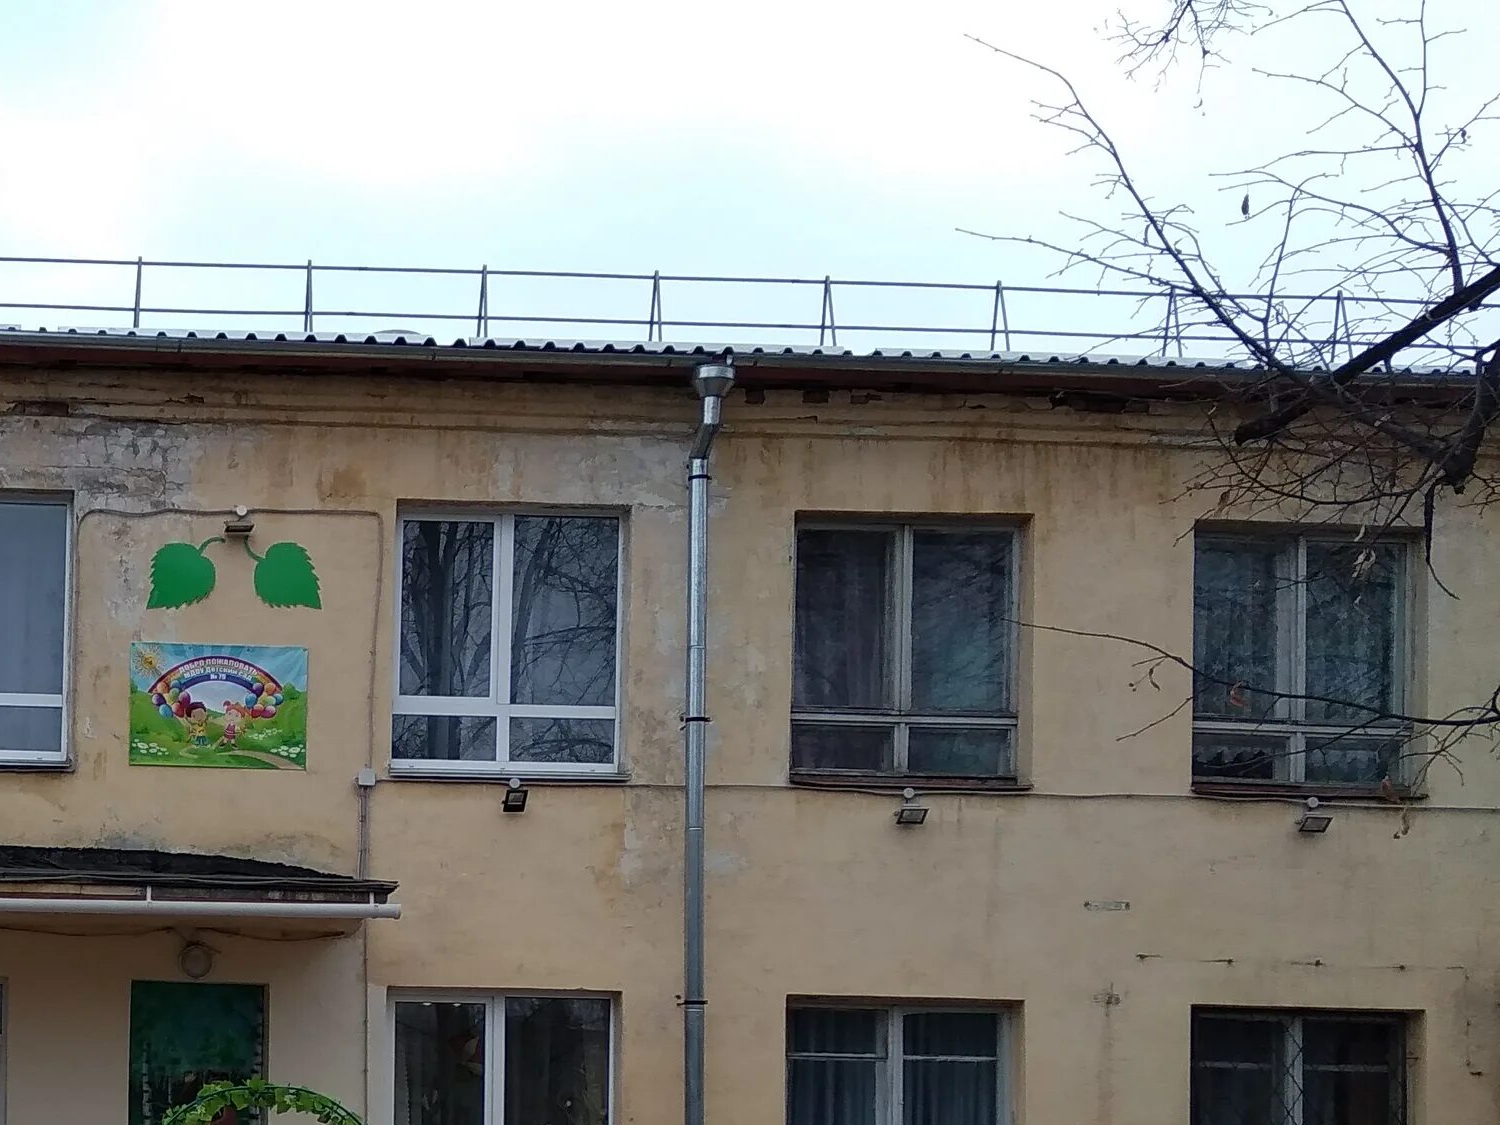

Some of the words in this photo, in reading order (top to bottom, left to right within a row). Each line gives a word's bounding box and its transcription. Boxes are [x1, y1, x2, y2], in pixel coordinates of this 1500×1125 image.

[179, 660, 205, 674] ДОБРО
[206, 658, 258, 676] ПОЖАЛОВАТЬ
[183, 668, 204, 678] МДОУ
